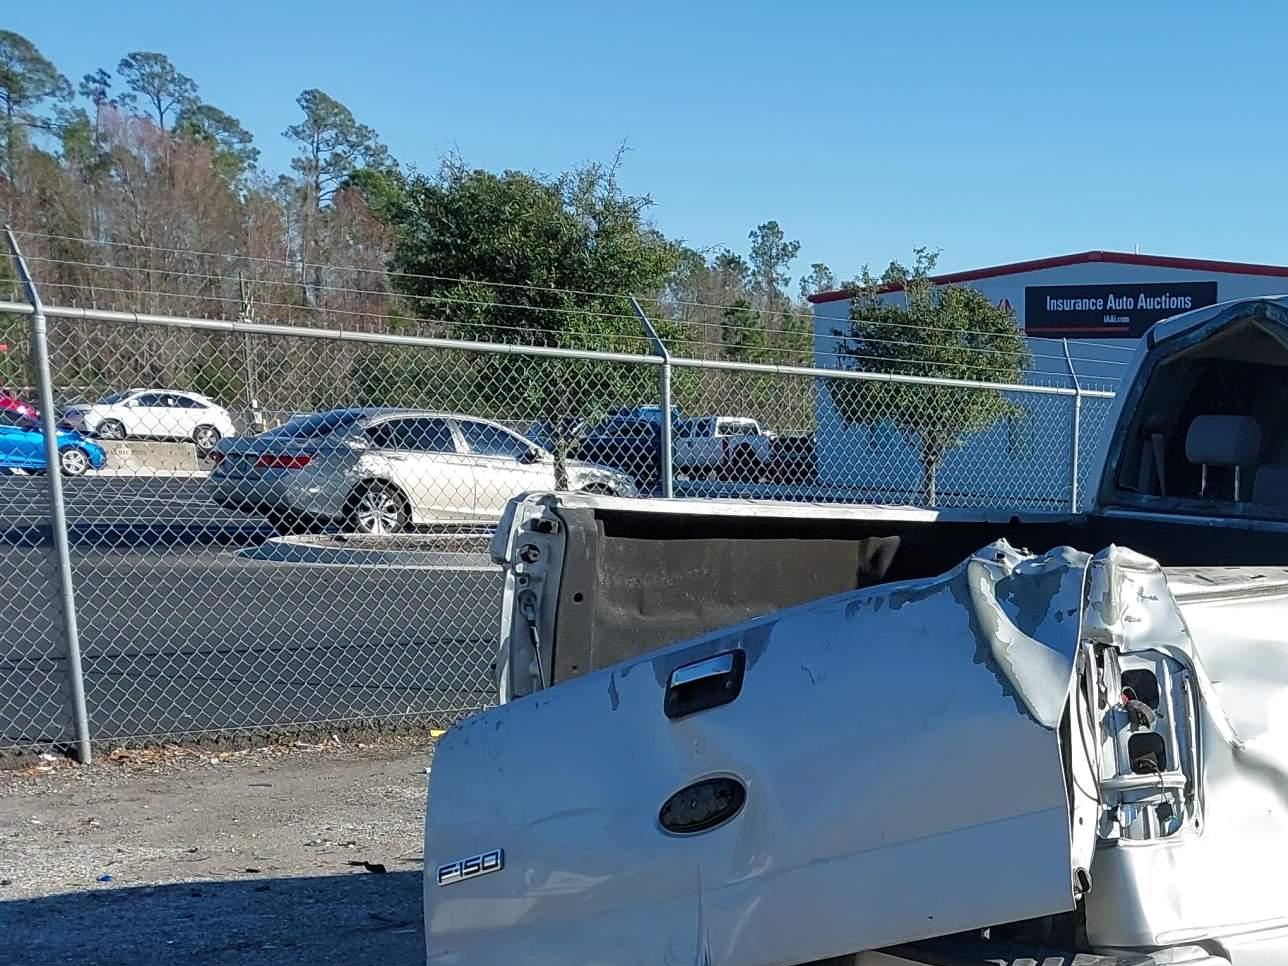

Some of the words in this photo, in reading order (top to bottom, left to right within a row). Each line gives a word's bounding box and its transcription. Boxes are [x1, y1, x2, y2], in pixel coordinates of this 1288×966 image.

[1046, 295, 1104, 311] Insurance
[1106, 294, 1134, 310] Auto
[1137, 292, 1192, 309] Auctions
